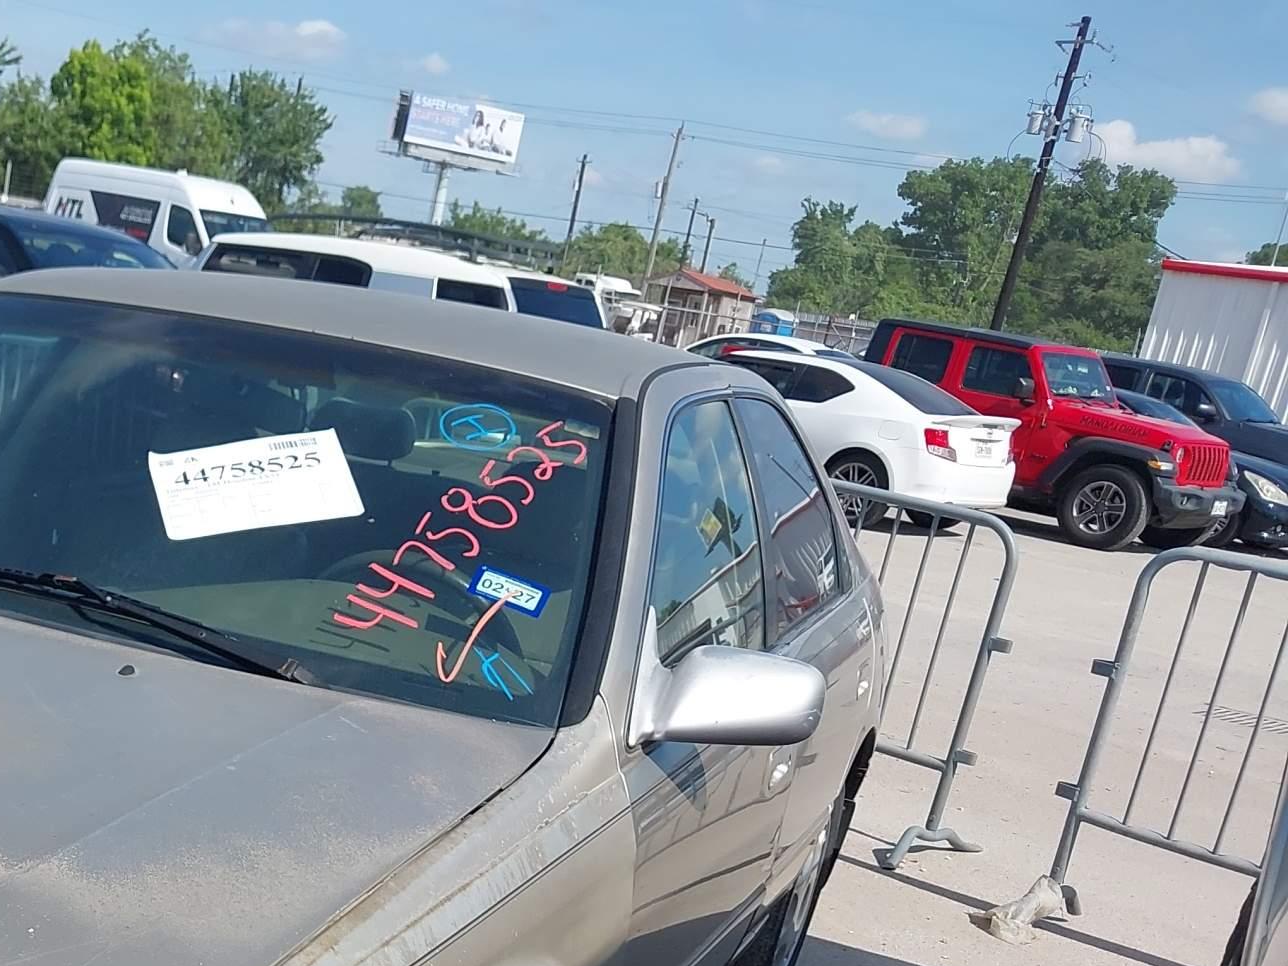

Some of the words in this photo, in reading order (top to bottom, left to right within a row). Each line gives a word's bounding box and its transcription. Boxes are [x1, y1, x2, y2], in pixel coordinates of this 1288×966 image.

[175, 452, 321, 485] 44758525
[333, 420, 587, 629] 44758525
[481, 578, 505, 594] 02
[511, 589, 537, 604] 27
